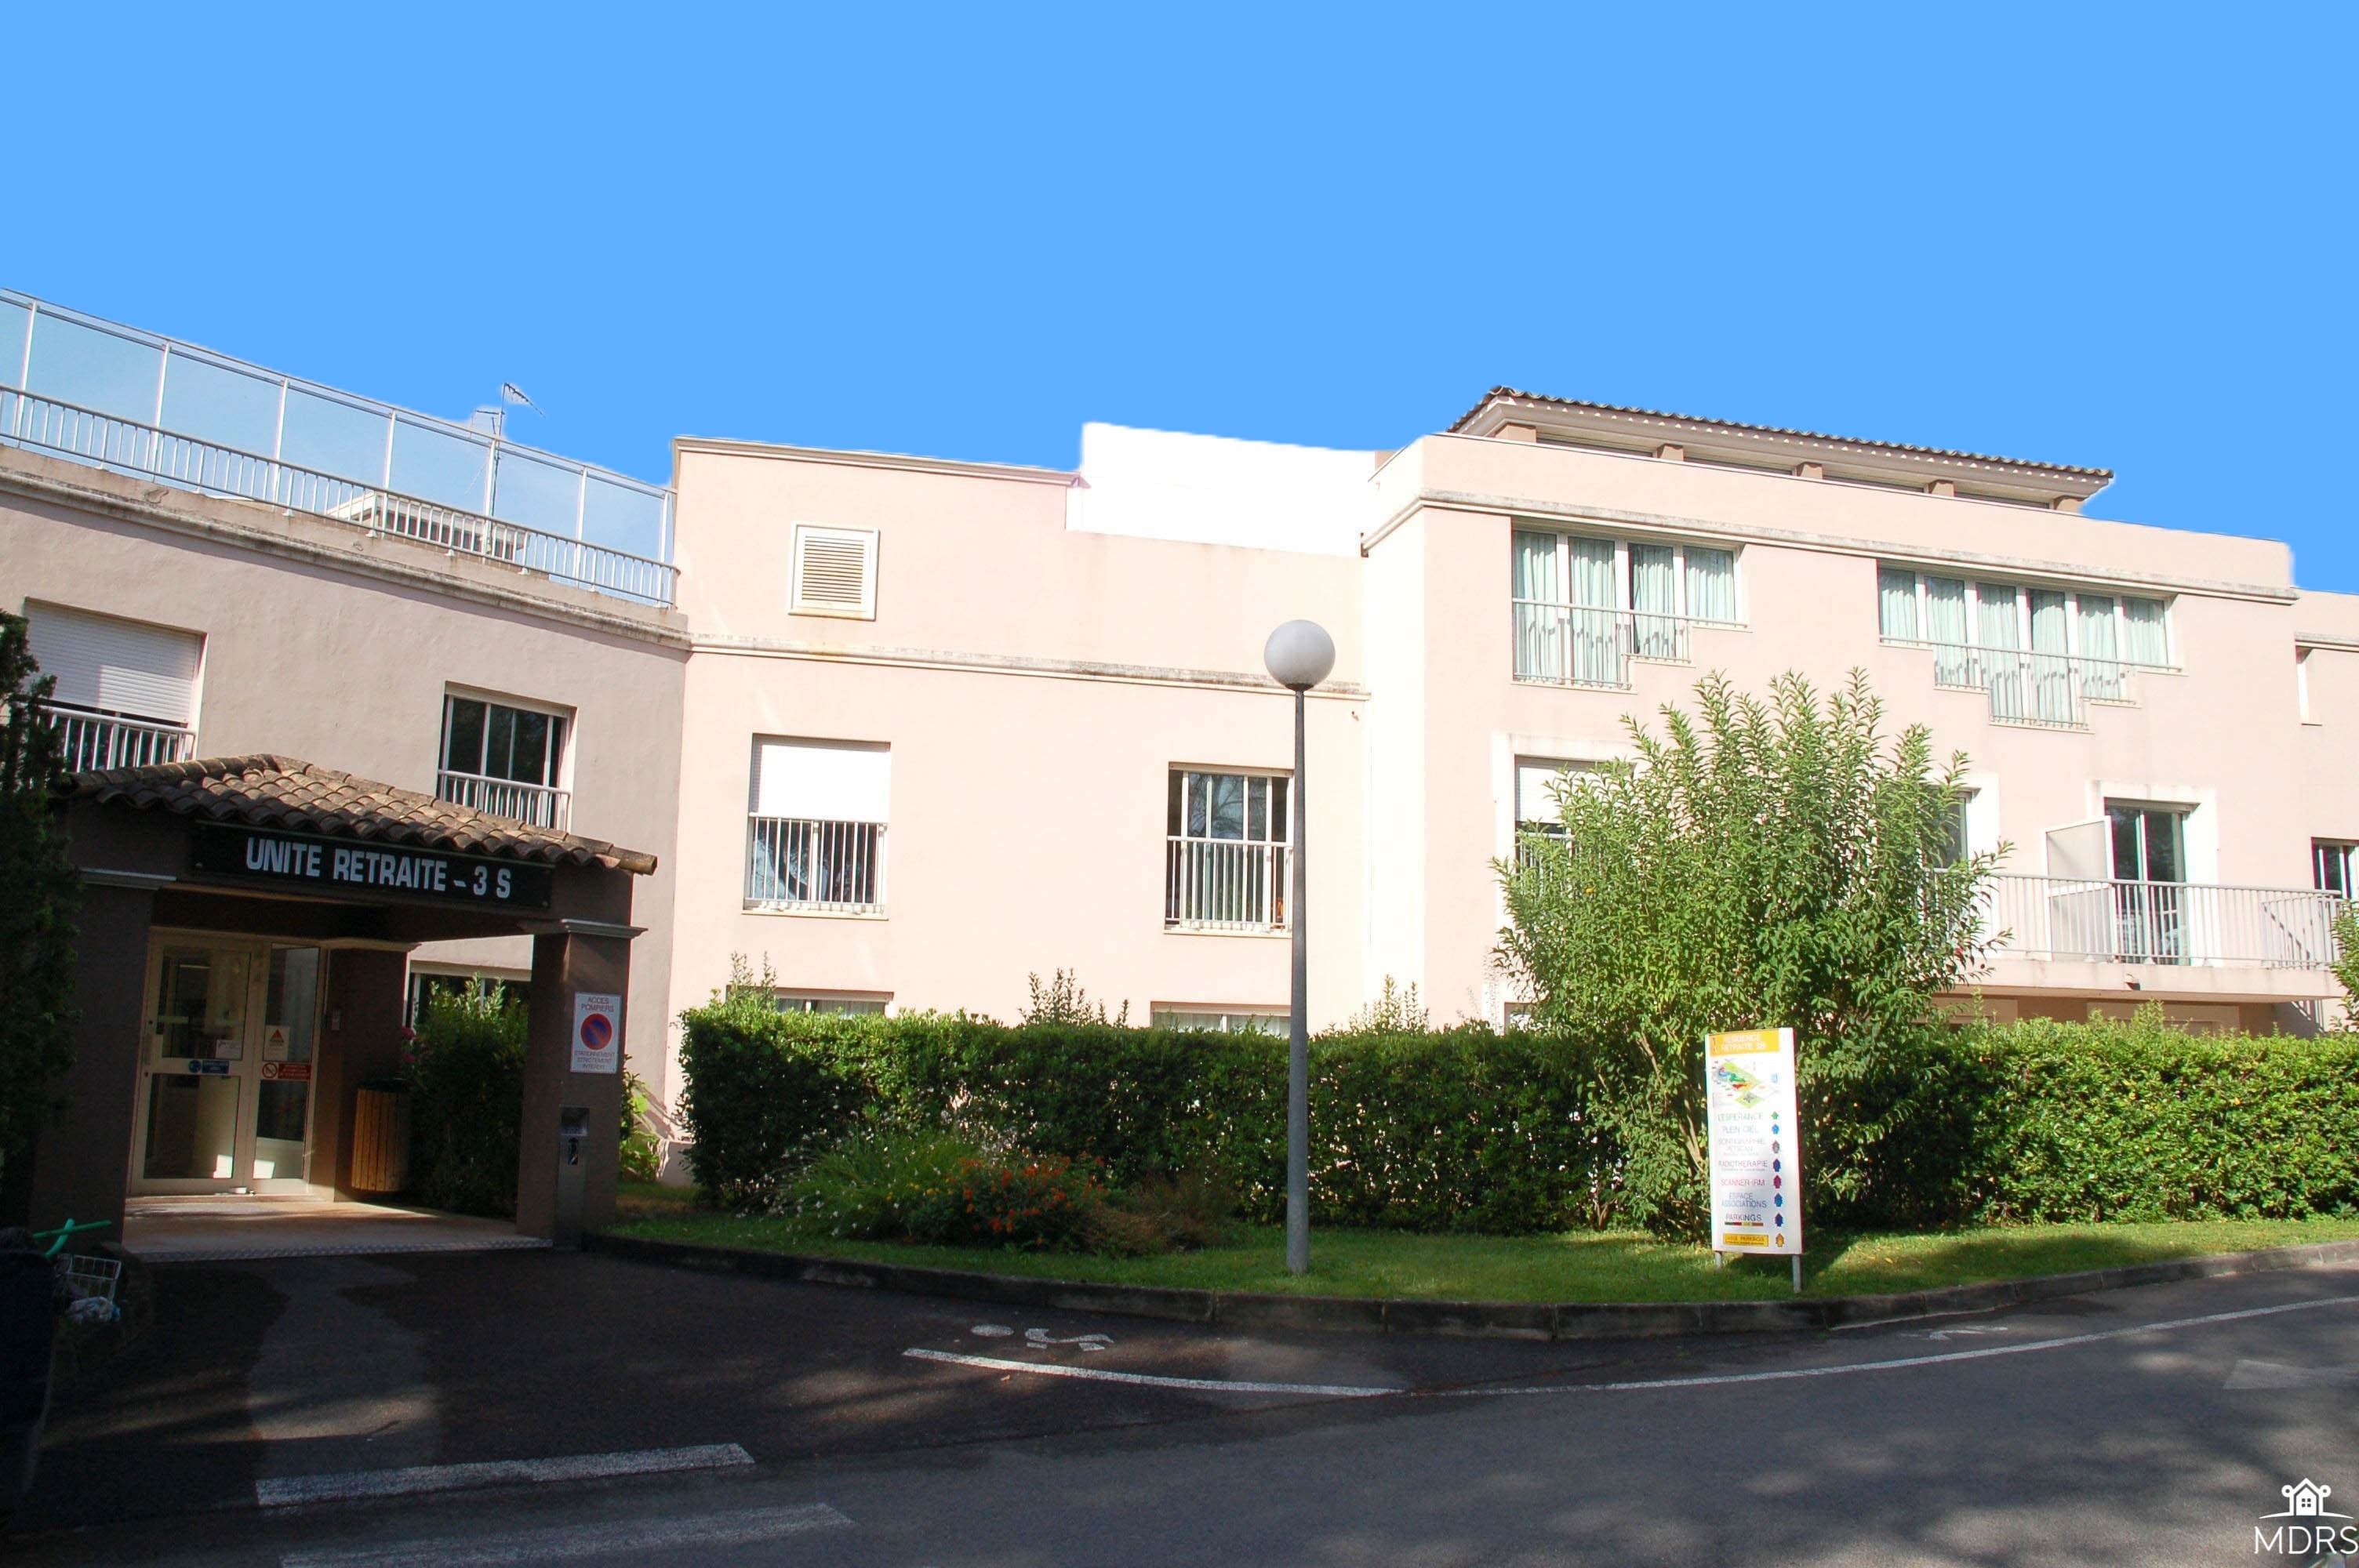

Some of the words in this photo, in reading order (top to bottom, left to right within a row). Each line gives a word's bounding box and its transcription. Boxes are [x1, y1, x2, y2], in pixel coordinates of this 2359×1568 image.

[246, 837, 322, 877] UNITE
[333, 848, 447, 891] RETRAITE
[473, 866, 488, 896] 3
[496, 868, 511, 898] S
[581, 1004, 615, 1012] POMPIERS
